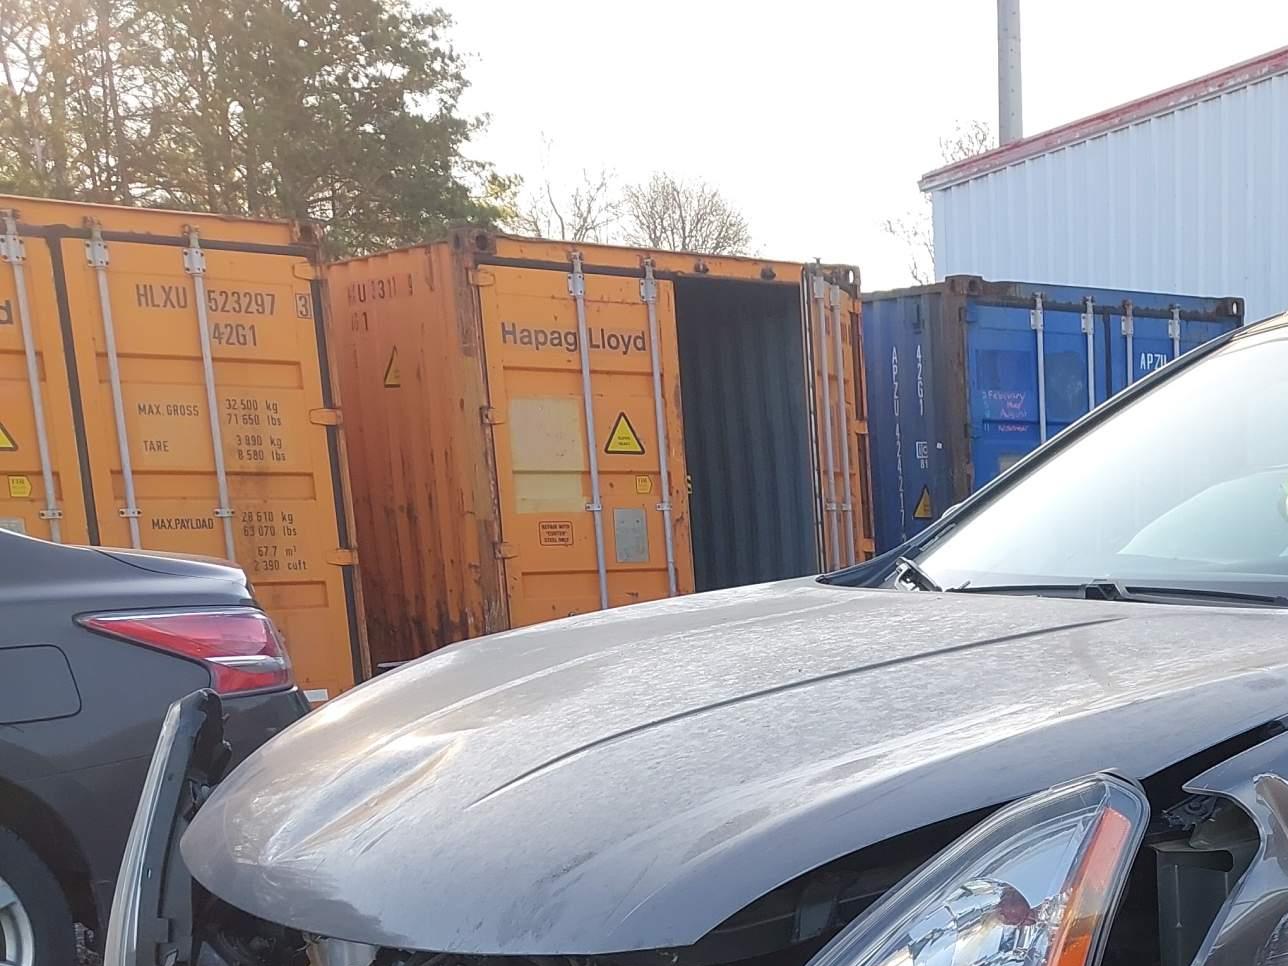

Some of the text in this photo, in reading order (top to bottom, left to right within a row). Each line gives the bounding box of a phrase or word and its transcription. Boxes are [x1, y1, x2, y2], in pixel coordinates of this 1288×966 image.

[136, 284, 309, 317] HLXU 523297 3
[212, 323, 257, 346] 42G1
[501, 321, 646, 355] Hapag Lloyd
[916, 344, 925, 416] 42G1
[167, 404, 199, 417] GROSS
[265, 400, 278, 414] kg
[267, 415, 282, 426] lbs
[144, 441, 169, 452] TARE
[270, 436, 282, 448] kg
[272, 451, 286, 461] lbs
[281, 512, 293, 524] kg
[283, 526, 297, 536] lbs
